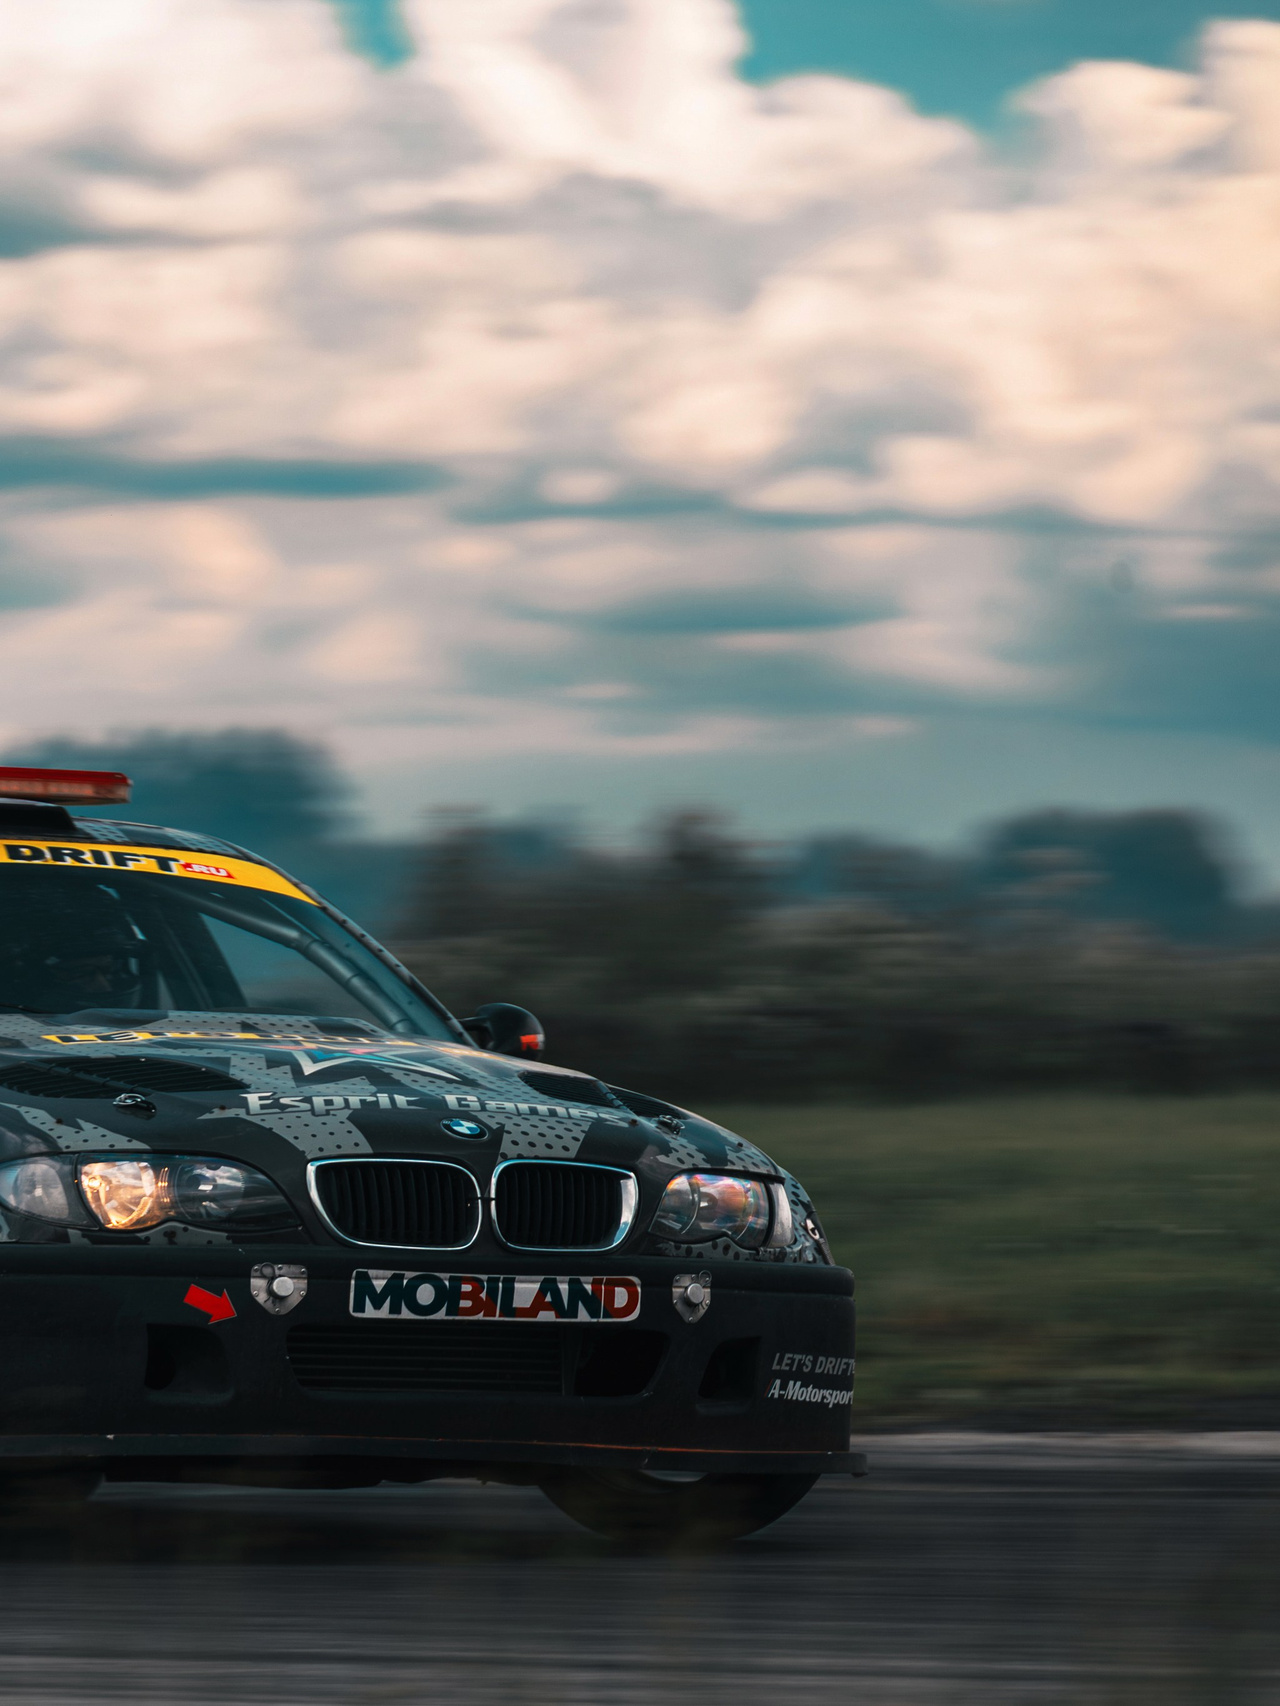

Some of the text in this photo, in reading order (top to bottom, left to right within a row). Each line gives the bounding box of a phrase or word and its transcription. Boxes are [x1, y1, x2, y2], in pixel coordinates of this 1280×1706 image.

[239, 1091, 630, 1128] Esprit Games
[351, 1269, 640, 1319] MOBILAND
[771, 1352, 856, 1377] LET'S DRIFT
